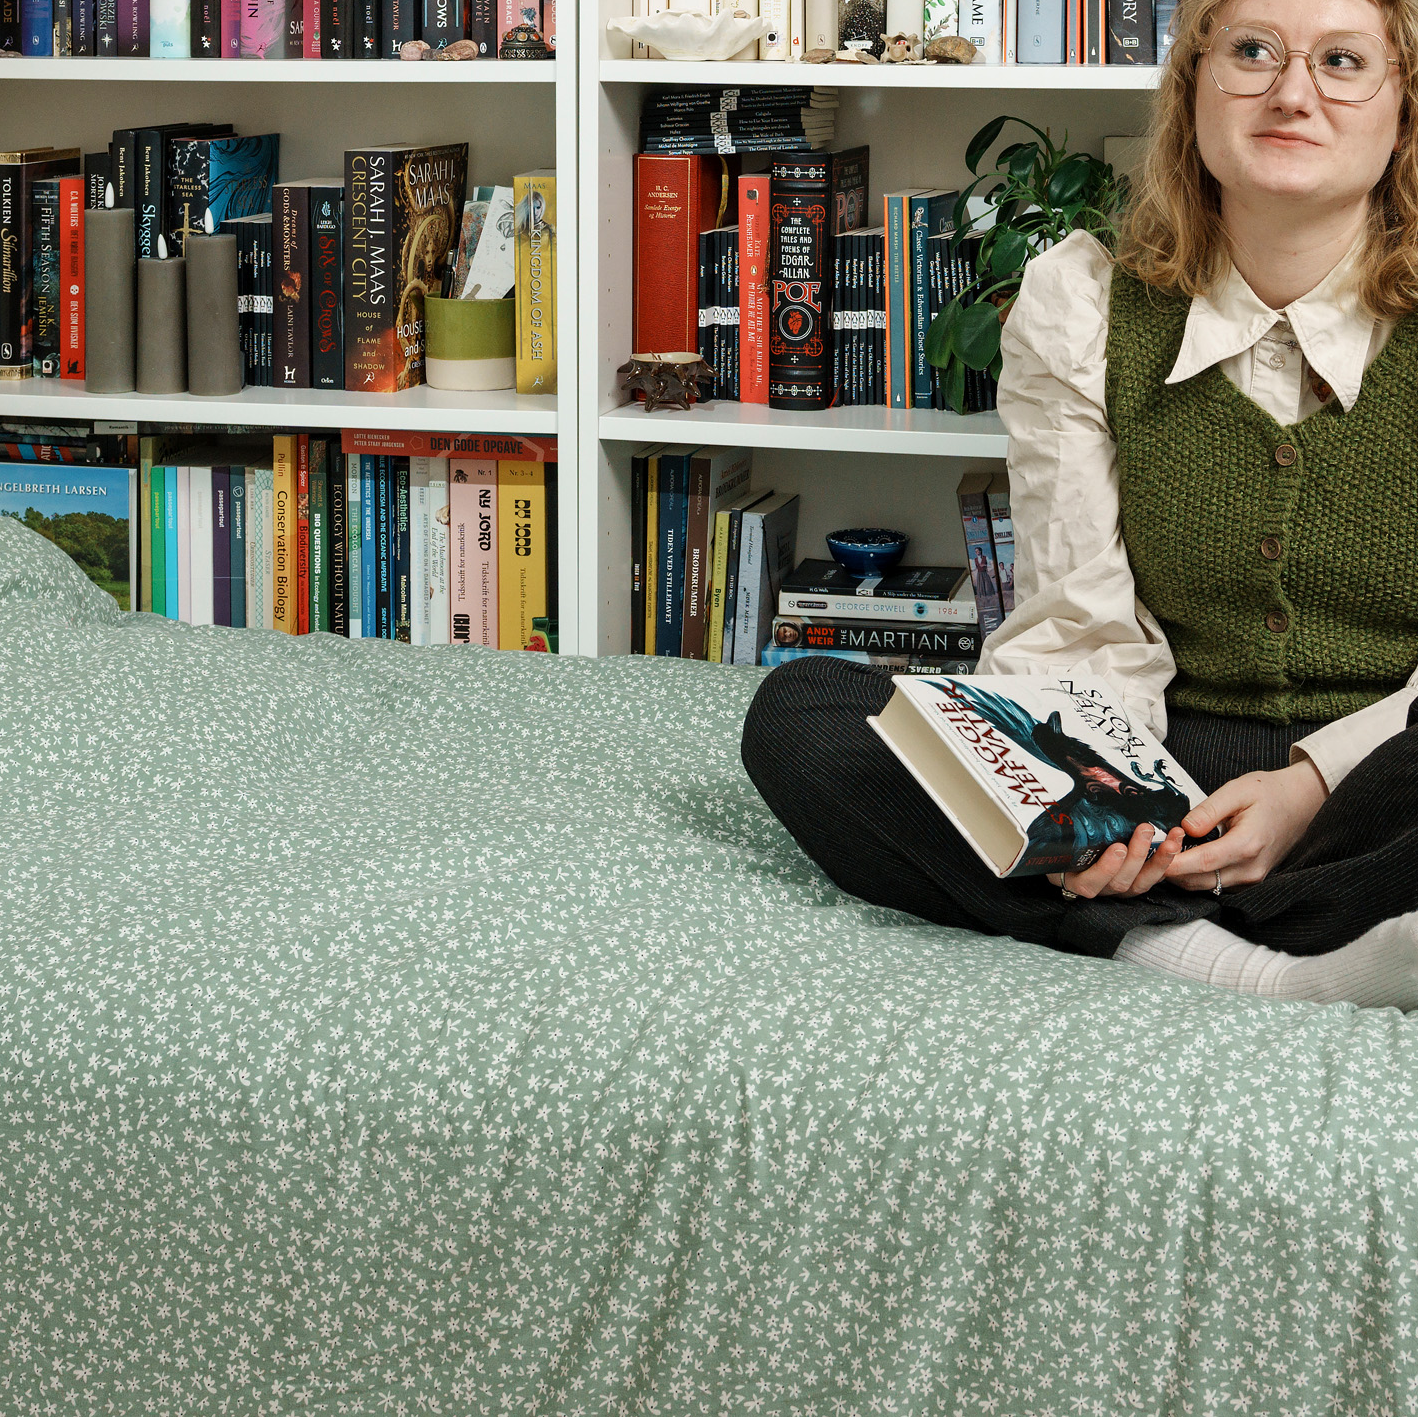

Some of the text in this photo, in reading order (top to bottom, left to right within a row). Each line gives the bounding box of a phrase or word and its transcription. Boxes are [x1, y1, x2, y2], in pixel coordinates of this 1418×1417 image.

[0, 177, 18, 293] TOLKIEN Silmarillion
[351, 156, 367, 303] CRESCENT CITY
[367, 156, 386, 305] SARAH J. MAAS
[915, 230, 924, 252] Classic
[779, 267, 810, 278] ALLAN
[781, 255, 814, 266] EDGAR
[915, 254, 924, 285] Victorian
[529, 229, 543, 360] KINGDOM OF ASH
[772, 279, 822, 313] POE
[915, 294, 924, 329] Edwardian
[915, 331, 926, 351] Ghost
[915, 353, 924, 375] Stories
[430, 436, 523, 454] DEN GODE OPGAVE
[64, 484, 108, 496] LARSEN
[399, 470, 408, 532] Eco-Aesthetics
[274, 490, 288, 622] Conservation Biology
[690, 547, 700, 617] BRØDKRUMMER
[835, 602, 958, 616] GEORGE ORWELL 1984
[806, 626, 835, 636] ANDY
[808, 636, 834, 646] WEIR
[849, 629, 948, 651] MARTIAN
[1082, 688, 1146, 749] BOYS
[938, 701, 1041, 808] MAGGIE
[942, 680, 1074, 826] STIEFVATER
